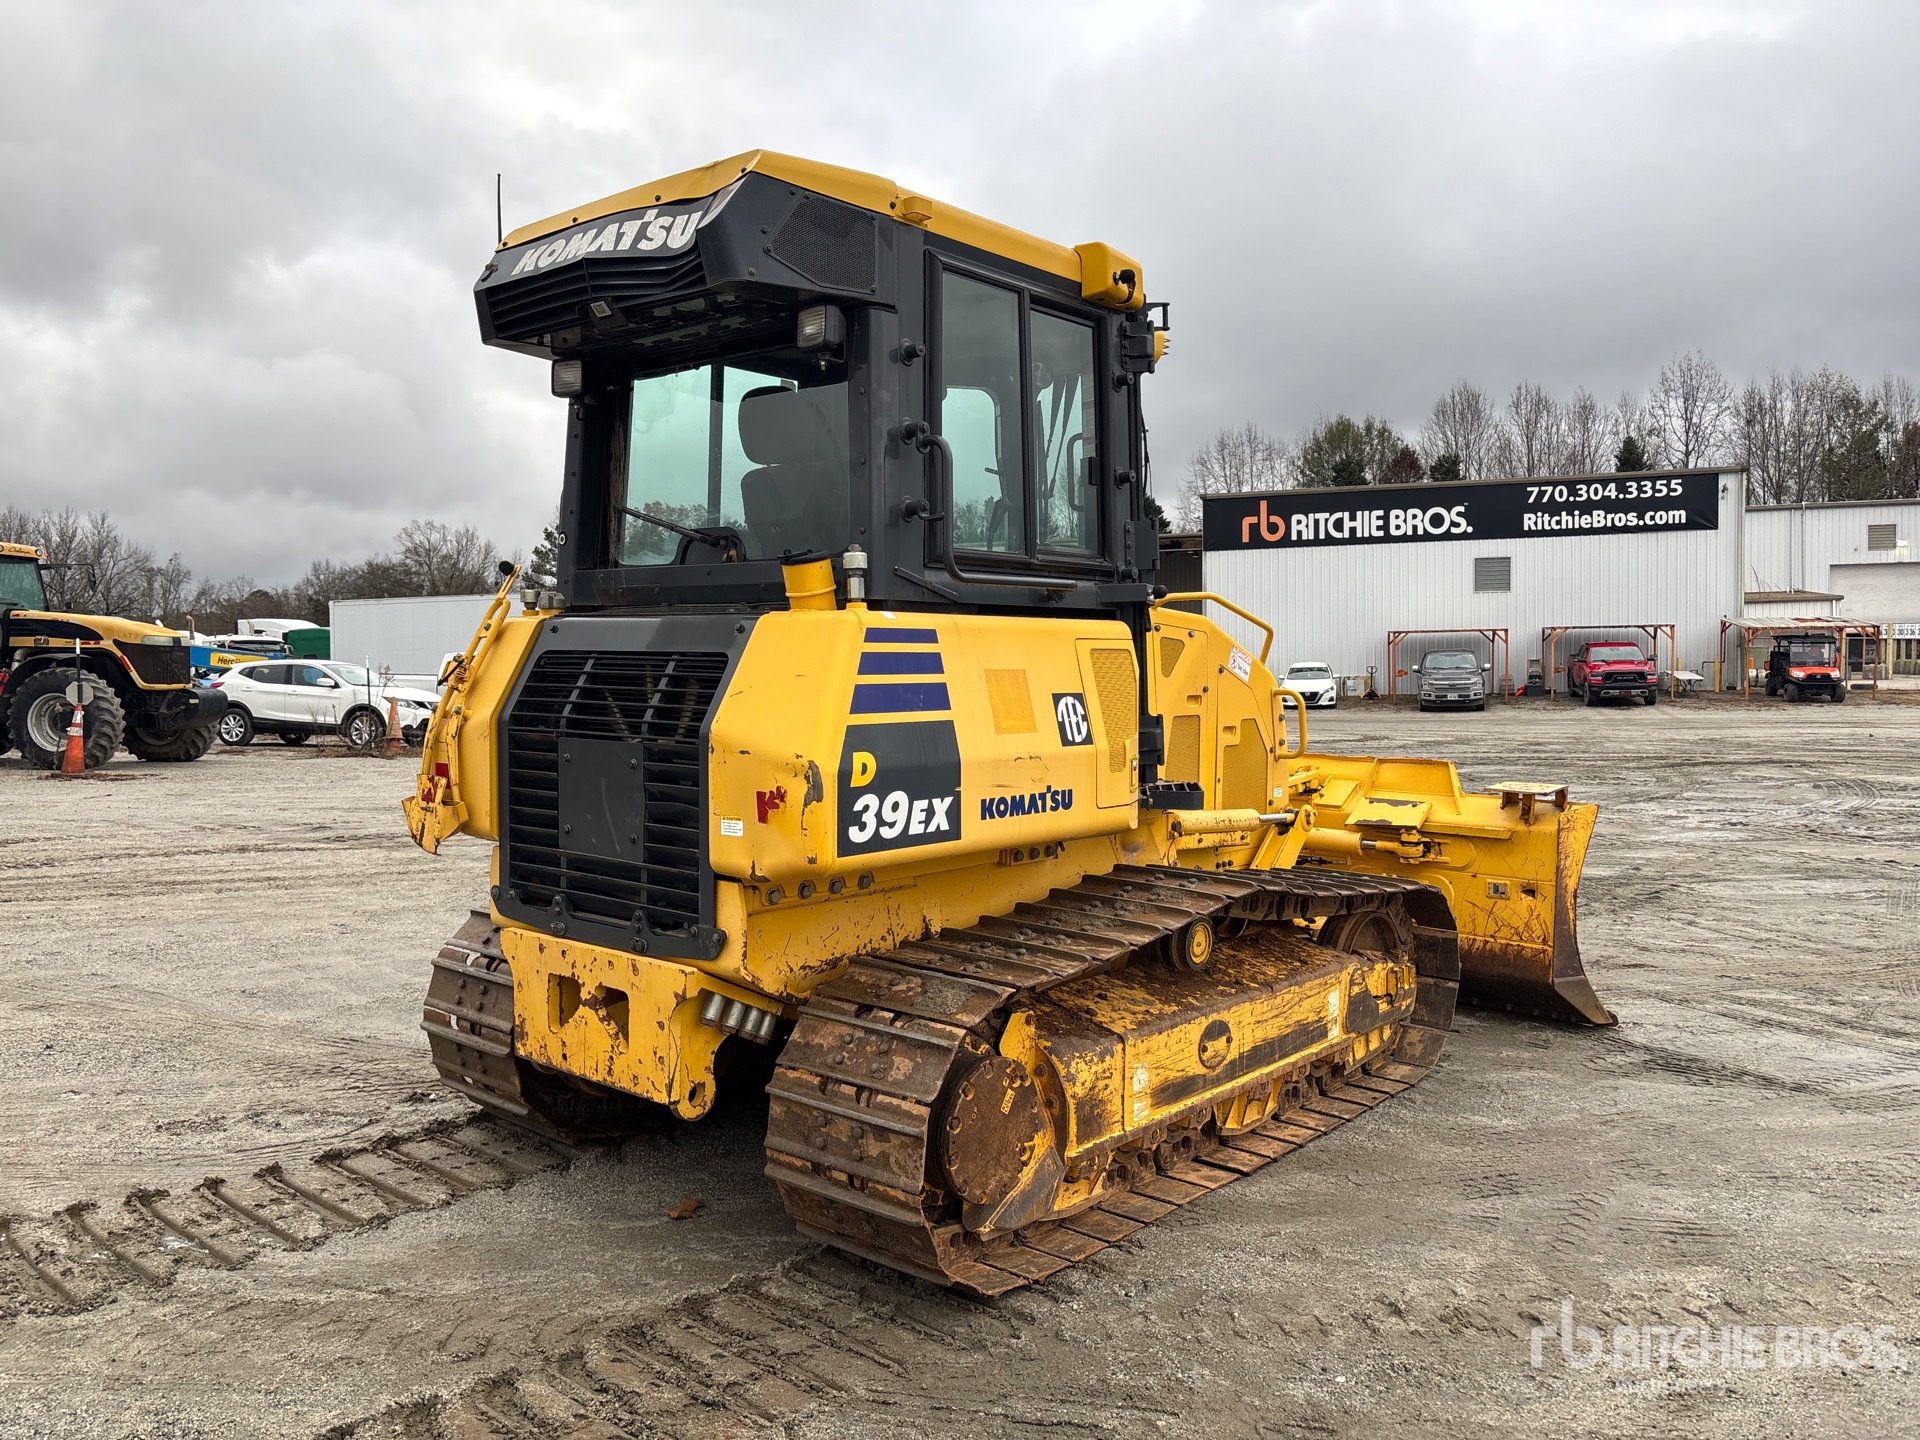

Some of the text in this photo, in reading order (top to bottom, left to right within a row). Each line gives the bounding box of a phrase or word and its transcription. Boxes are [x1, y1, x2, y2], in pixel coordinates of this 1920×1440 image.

[1526, 479, 1683, 504] 770.304.3355
[1242, 500, 1473, 543] rb RITCHIE BROS.
[1523, 509, 1687, 531] RitchieBros.com
[850, 751, 877, 788] D
[848, 790, 954, 844] 39EX
